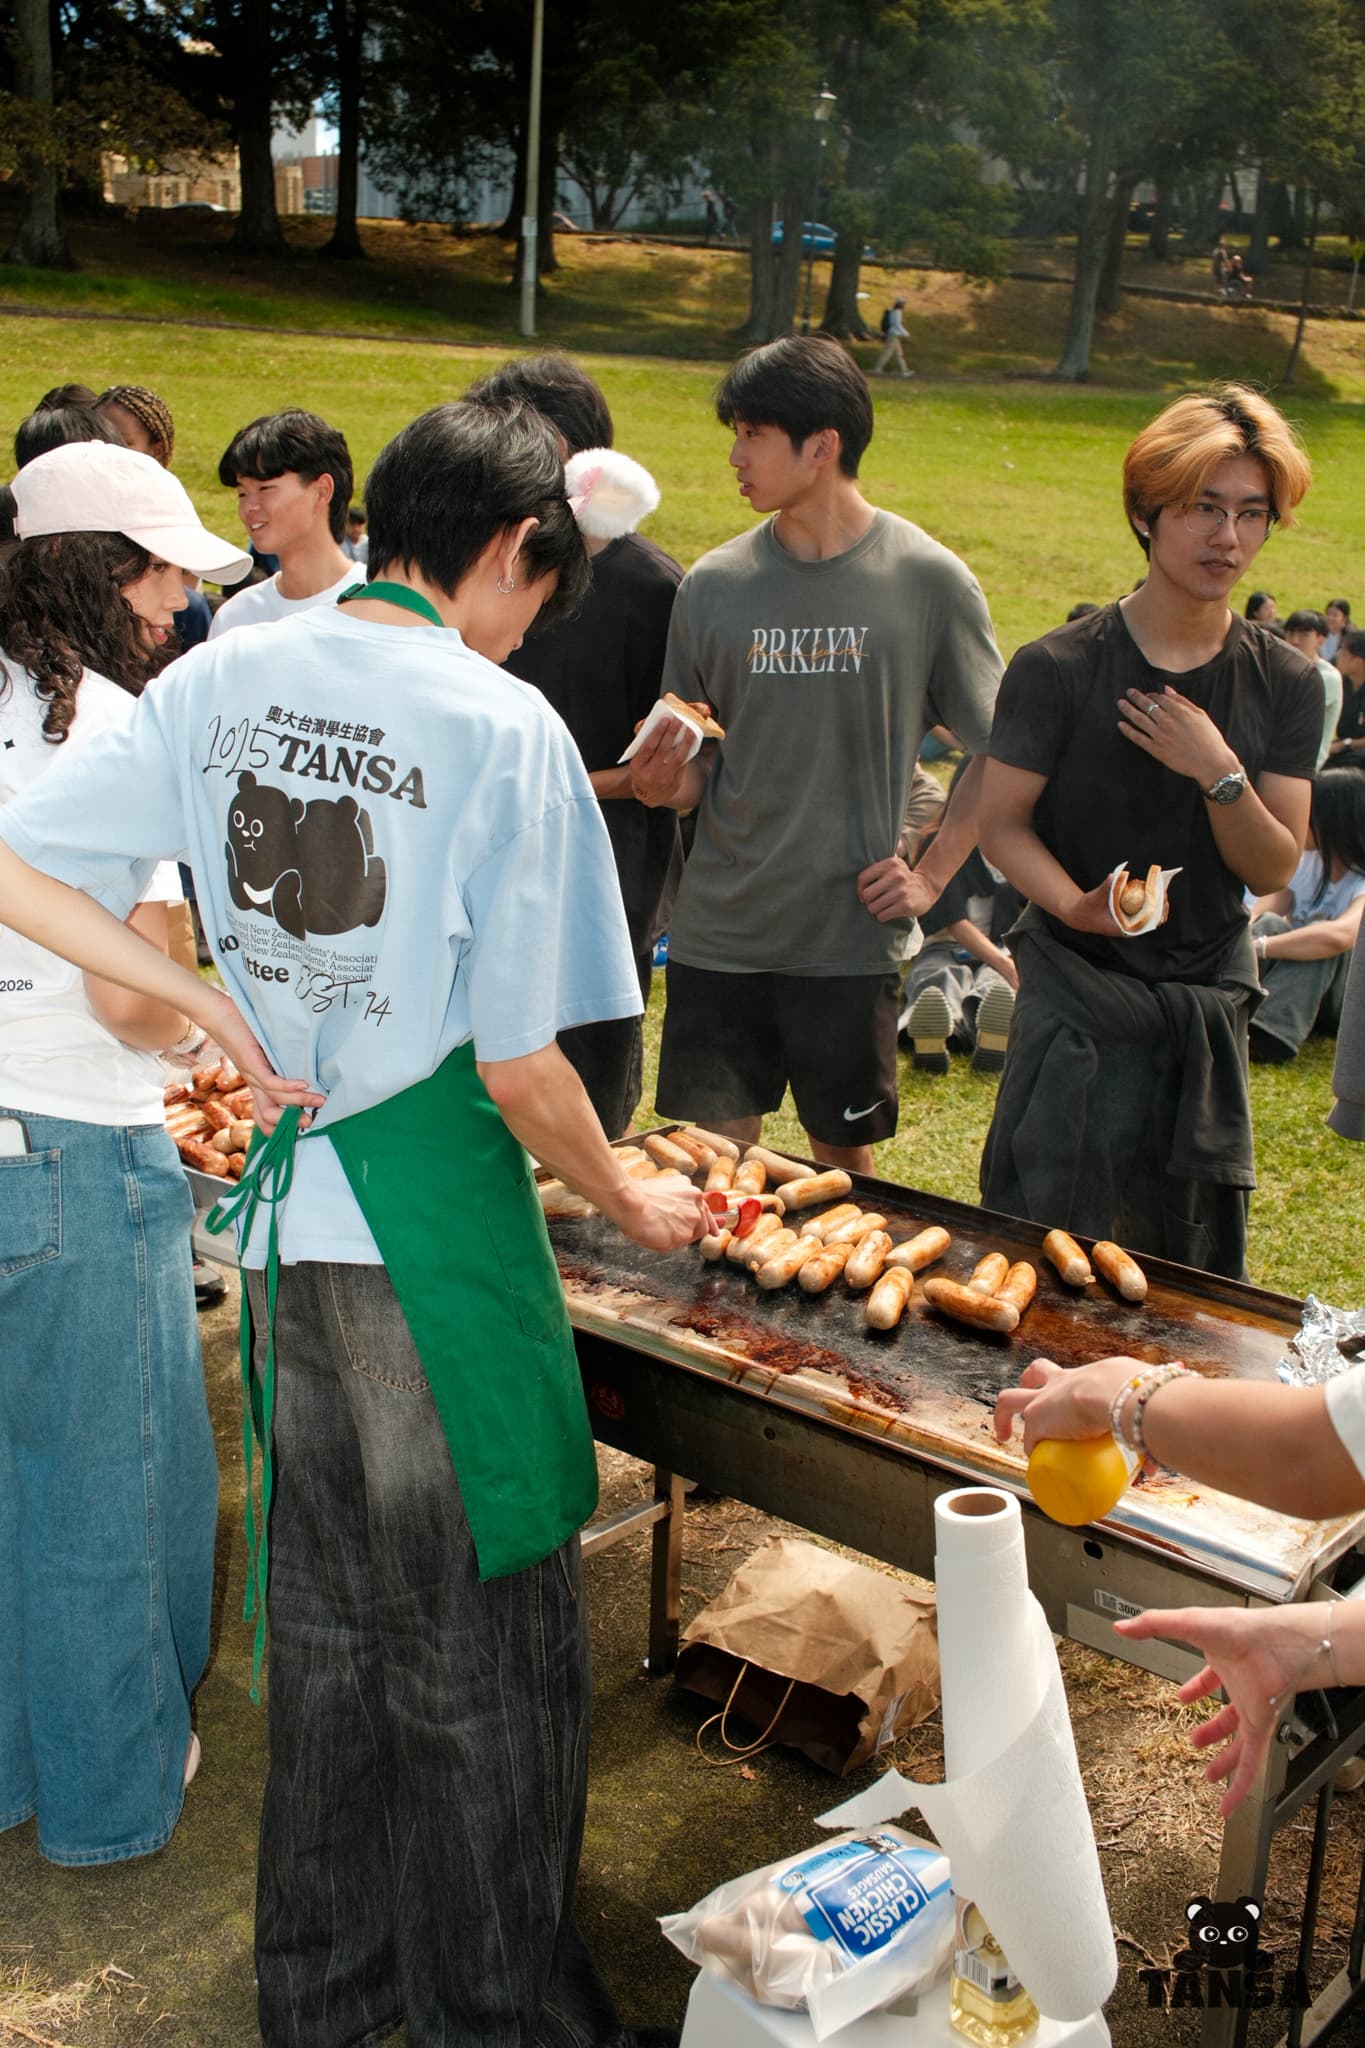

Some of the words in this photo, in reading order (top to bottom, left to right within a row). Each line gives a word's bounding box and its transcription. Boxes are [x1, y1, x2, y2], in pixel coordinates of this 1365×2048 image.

[751, 627, 868, 674] BRKLYN
[265, 705, 386, 748] 奧大台灣學生協會
[278, 734, 428, 809] TANSA
[0, 979, 33, 991] 2026
[837, 1873, 908, 1931] CHICKEN
[847, 1862, 895, 1898] SAUSAGES
[853, 1889, 920, 1946] CLASSIC
